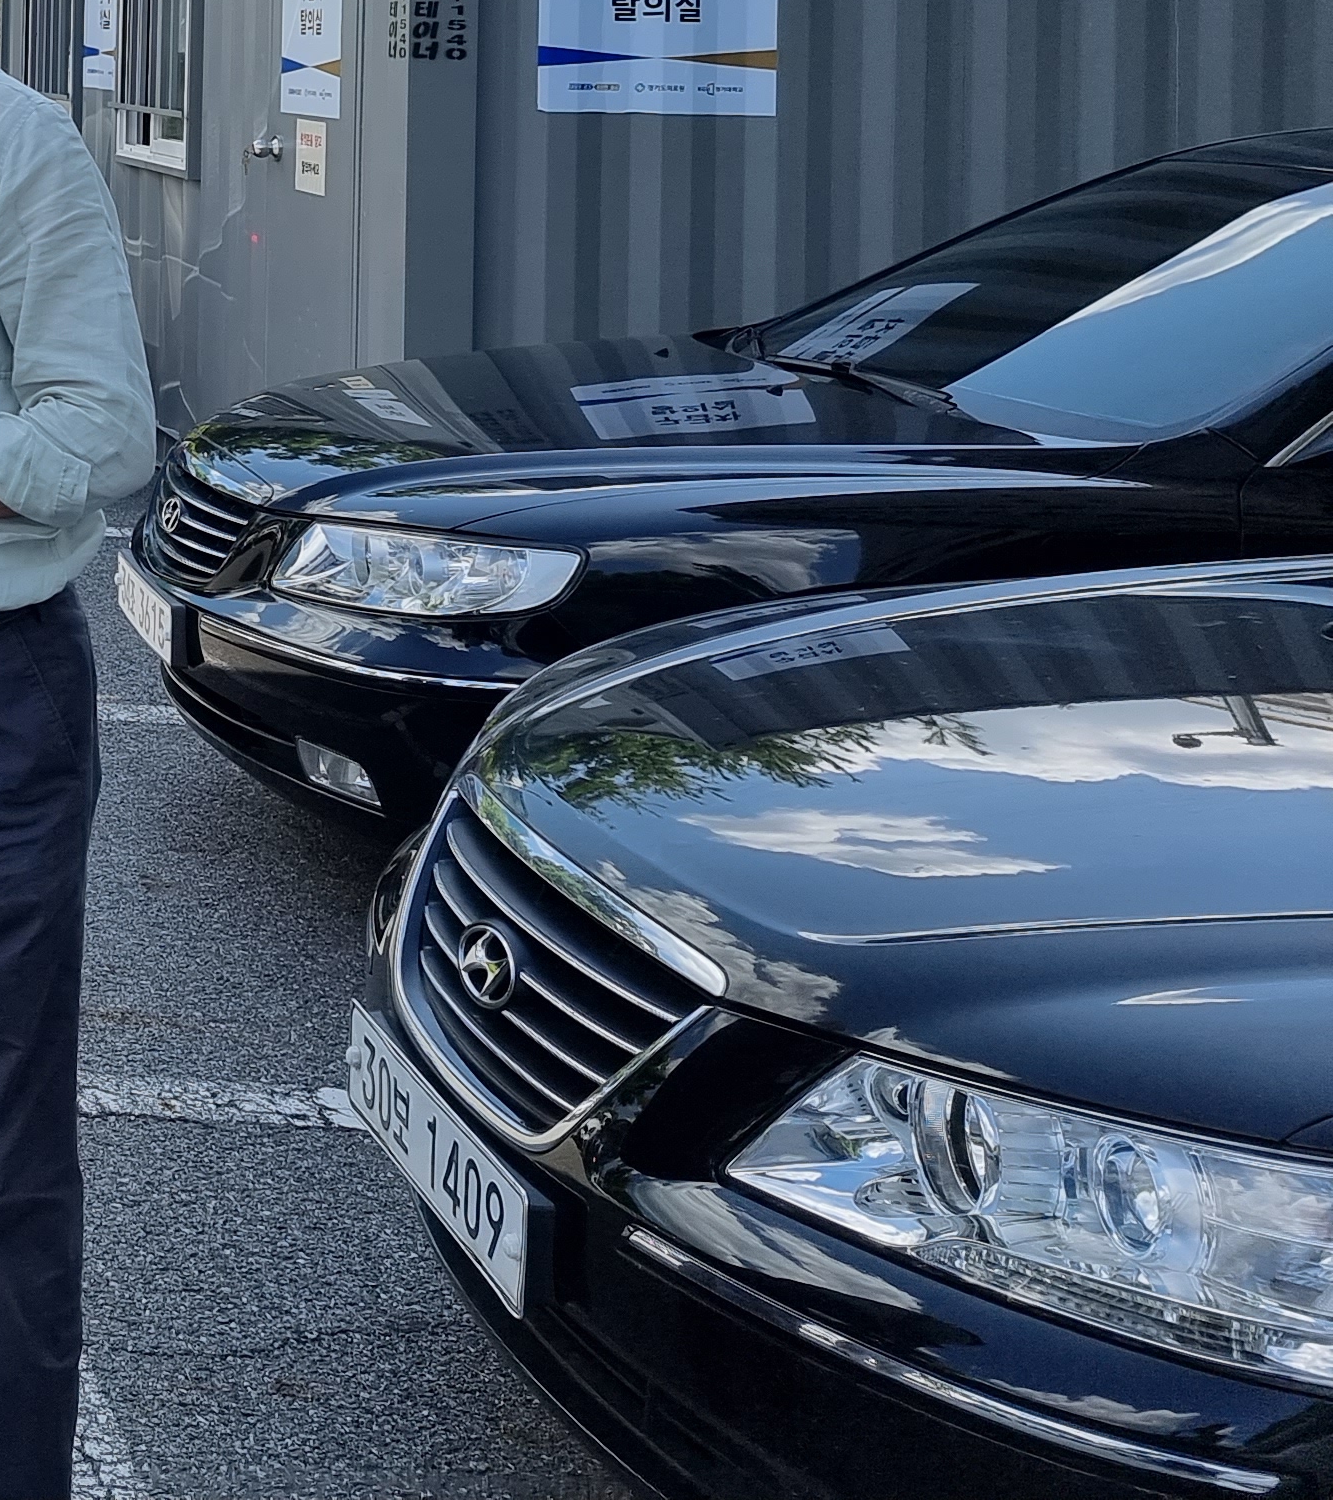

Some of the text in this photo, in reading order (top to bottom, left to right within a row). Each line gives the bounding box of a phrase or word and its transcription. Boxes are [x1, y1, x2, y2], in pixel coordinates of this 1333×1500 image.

[300, 9, 323, 36] 탈의실
[138, 587, 165, 650] 3615
[427, 1115, 504, 1260] 1409
